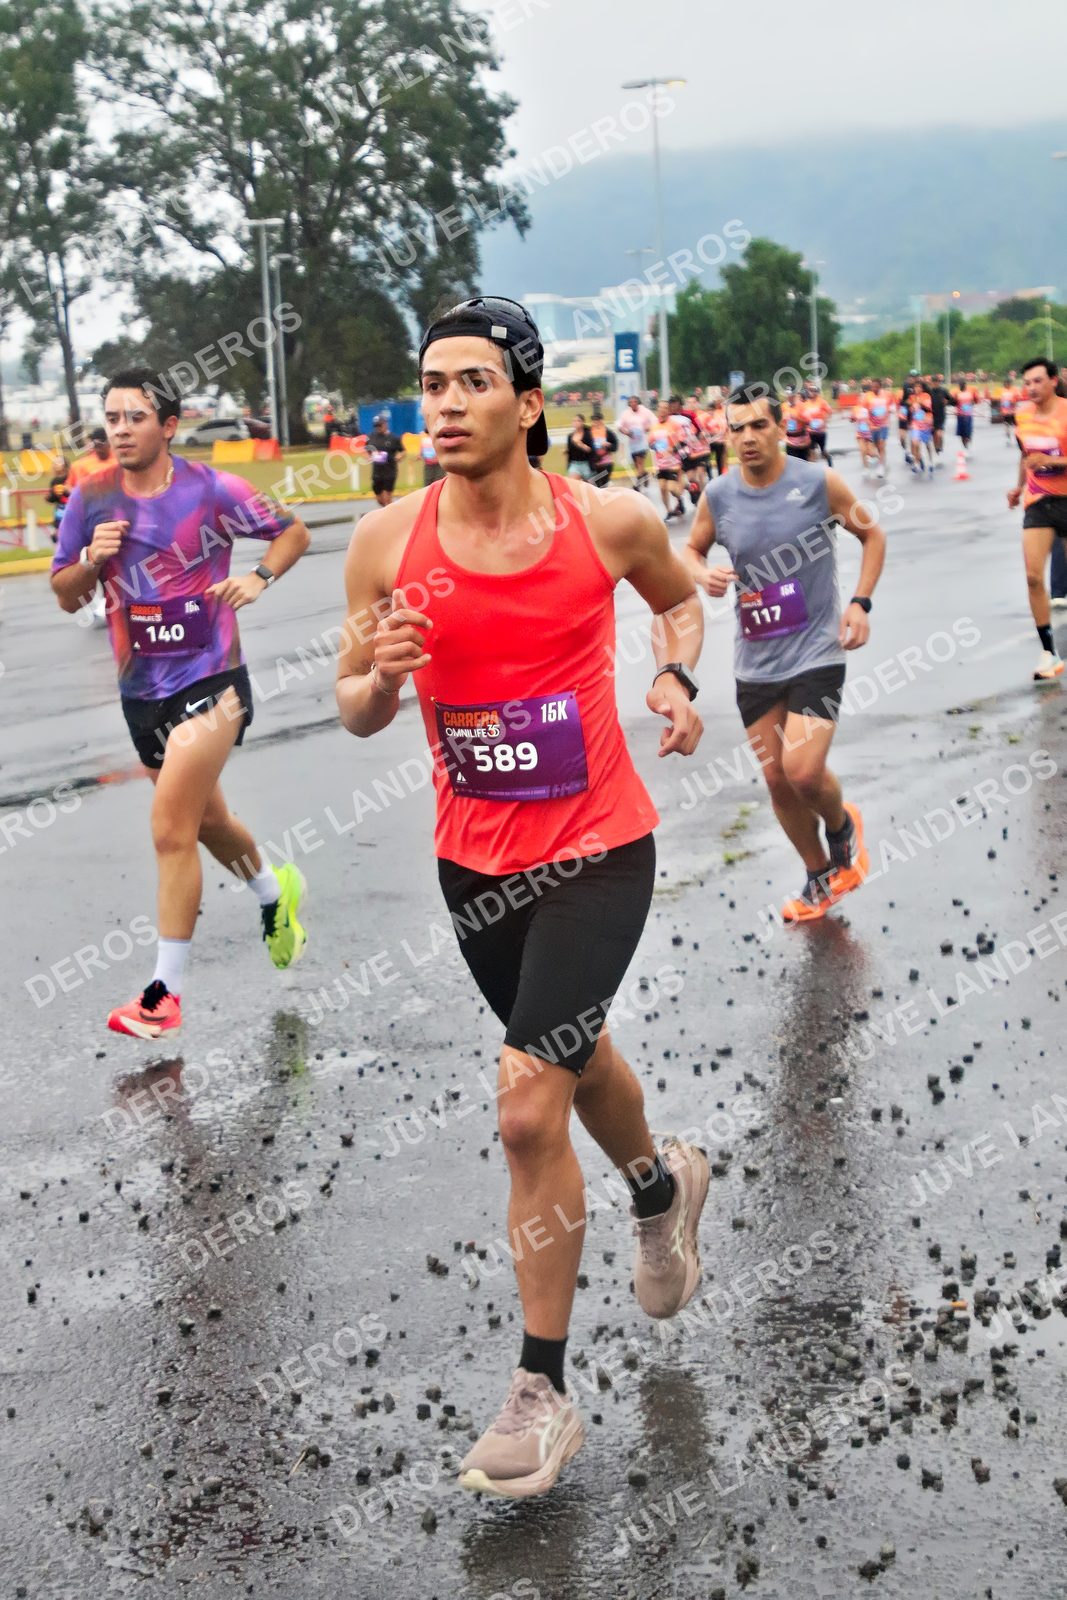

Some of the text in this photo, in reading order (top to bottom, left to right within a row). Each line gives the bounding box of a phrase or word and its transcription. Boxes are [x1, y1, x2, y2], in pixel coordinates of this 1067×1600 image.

[618, 349, 634, 368] E
[752, 605, 781, 625] 117
[146, 623, 185, 643] 140
[443, 710, 499, 727] CARRERA
[541, 700, 568, 724] 15K
[474, 742, 538, 772] 589
